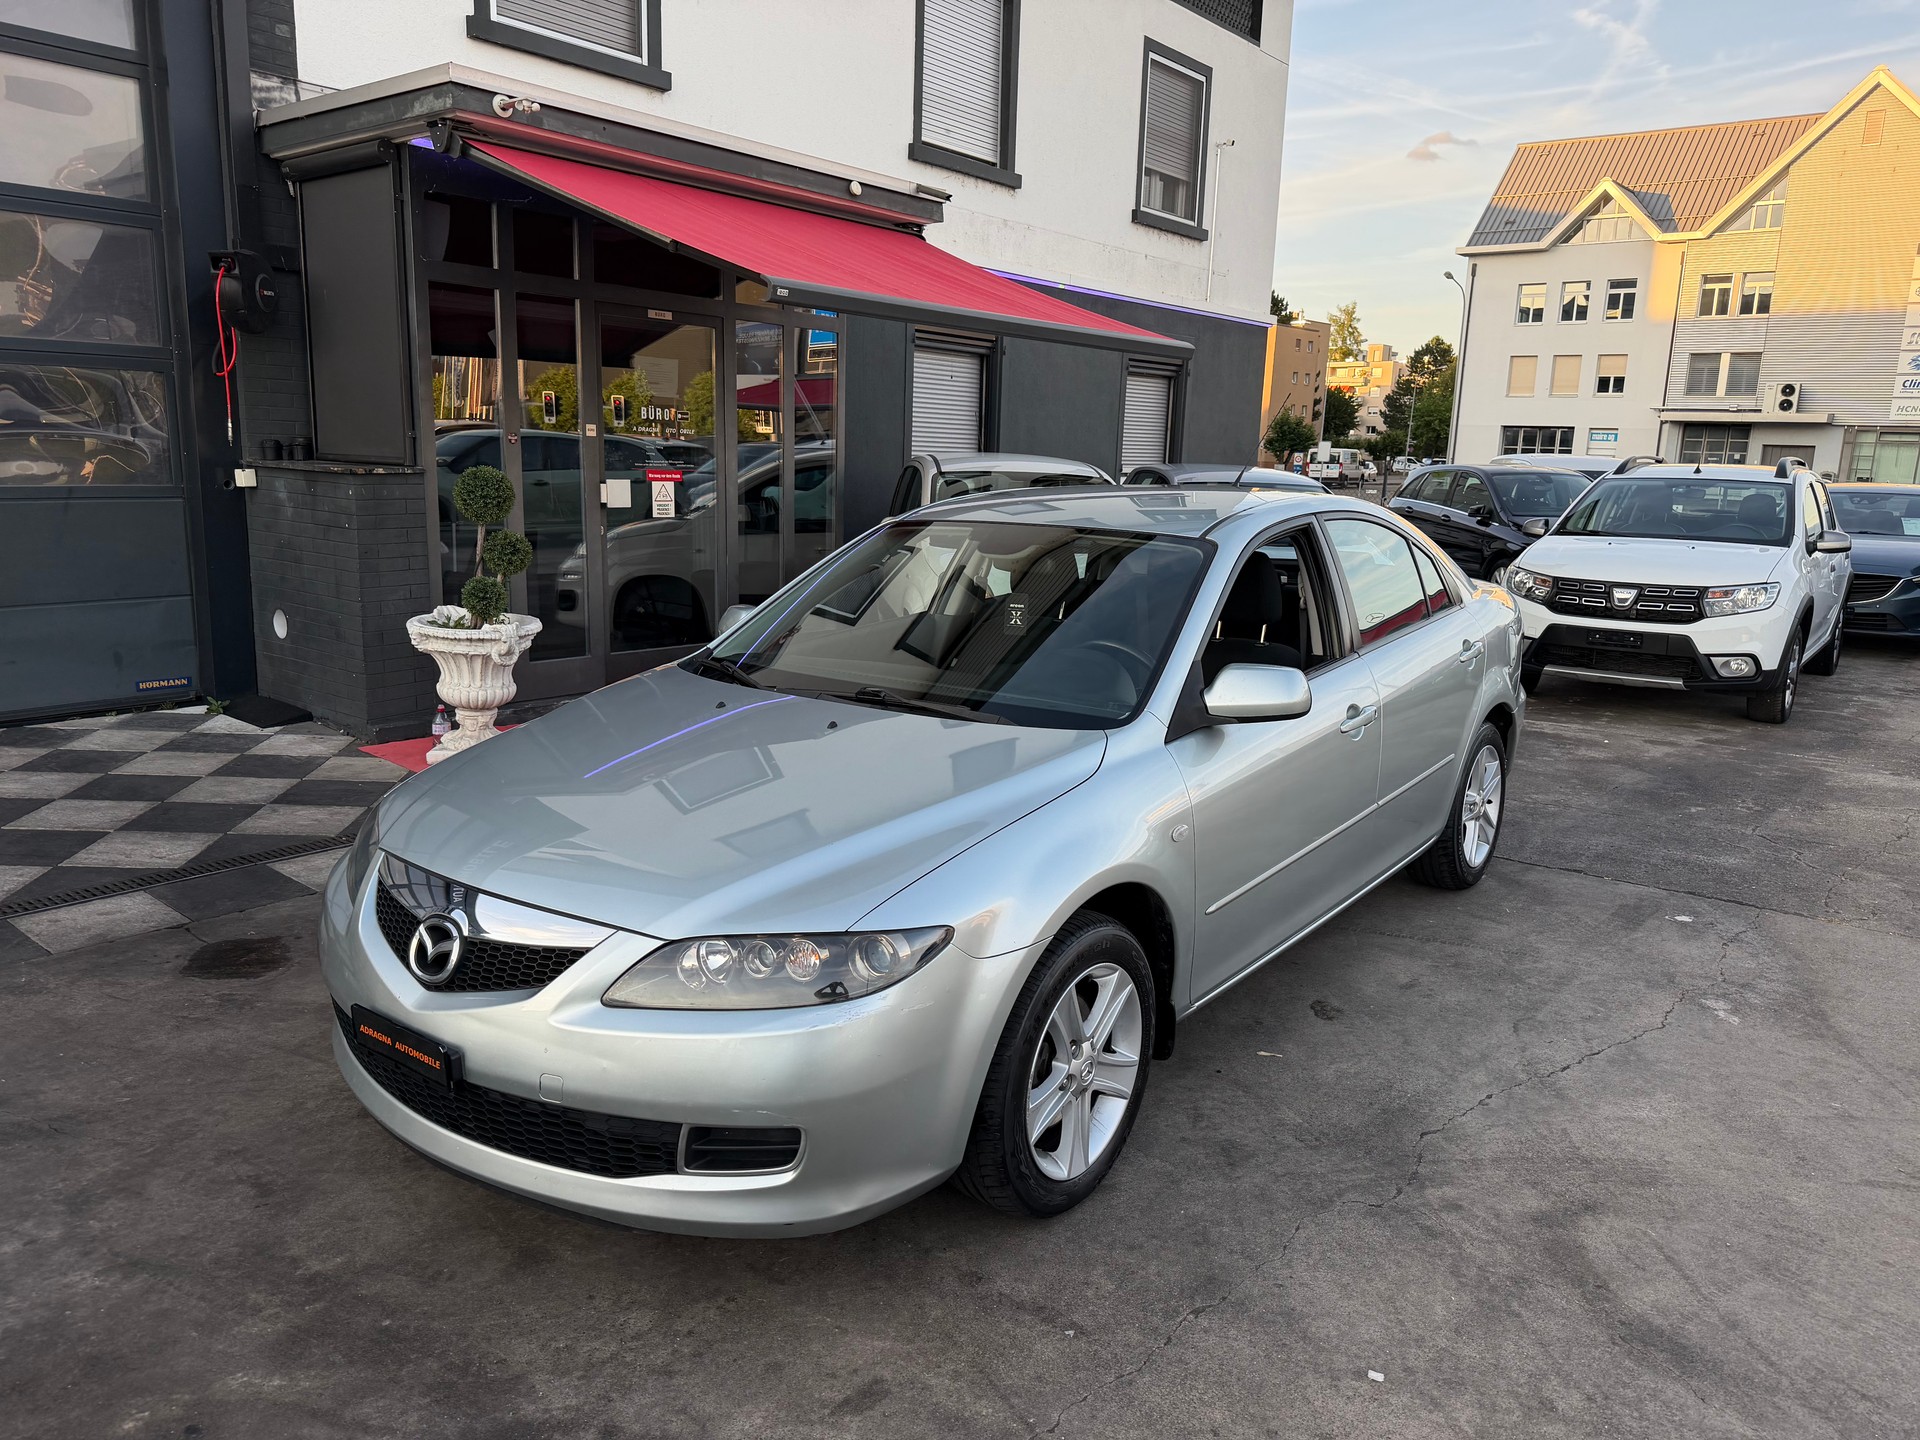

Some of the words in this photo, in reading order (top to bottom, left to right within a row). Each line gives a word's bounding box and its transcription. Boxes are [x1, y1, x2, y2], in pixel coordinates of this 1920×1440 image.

[641, 405, 670, 421] BÜRO
[360, 1024, 393, 1047] ADRAGNA
[395, 1041, 441, 1071] AUTOMOBILE
